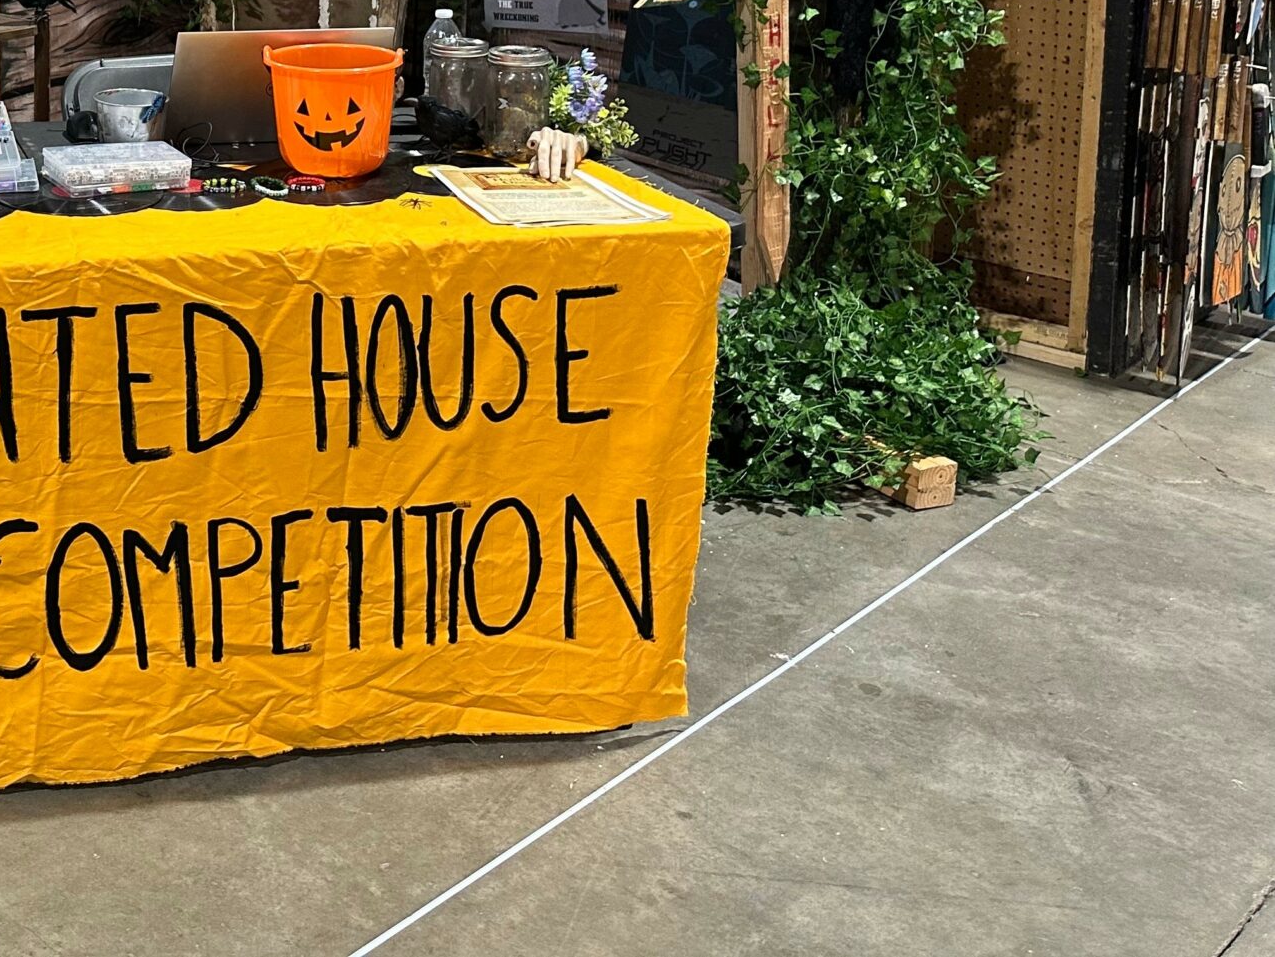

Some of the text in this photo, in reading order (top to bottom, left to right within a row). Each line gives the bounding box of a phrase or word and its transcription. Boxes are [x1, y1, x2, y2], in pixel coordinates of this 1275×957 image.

[498, 0, 533, 9] THE TRUE
[493, 12, 539, 22] WRECKONING
[311, 283, 620, 452] HOUSE
